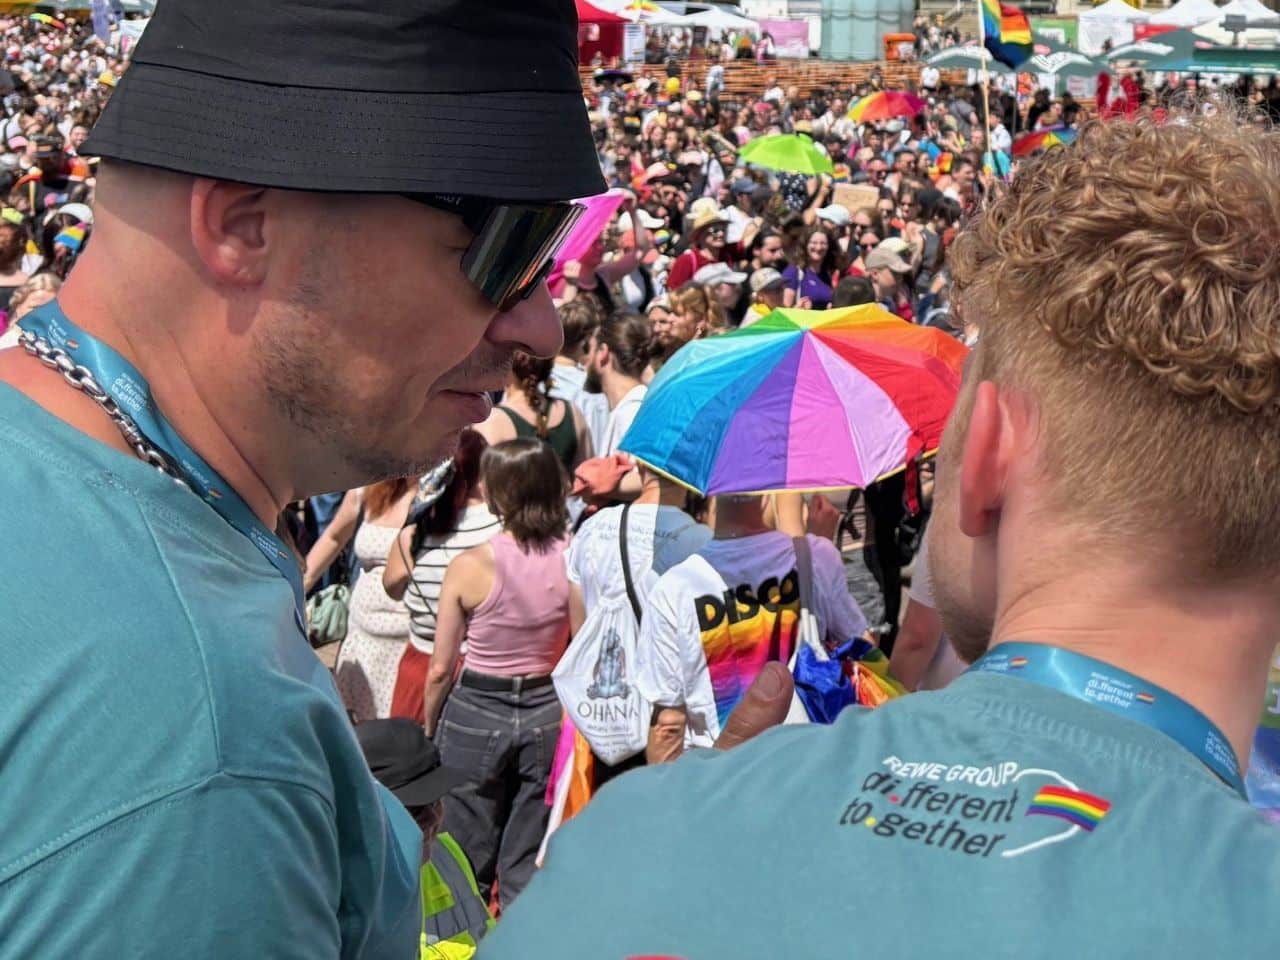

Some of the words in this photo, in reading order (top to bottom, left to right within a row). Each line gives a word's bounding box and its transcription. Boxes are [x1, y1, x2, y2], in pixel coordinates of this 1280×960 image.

[695, 569, 800, 632] DISCO
[861, 771, 1018, 824] di.fferent
[882, 755, 946, 781] REWE
[945, 761, 1018, 787] GROUP
[839, 797, 1007, 858] to.gether
